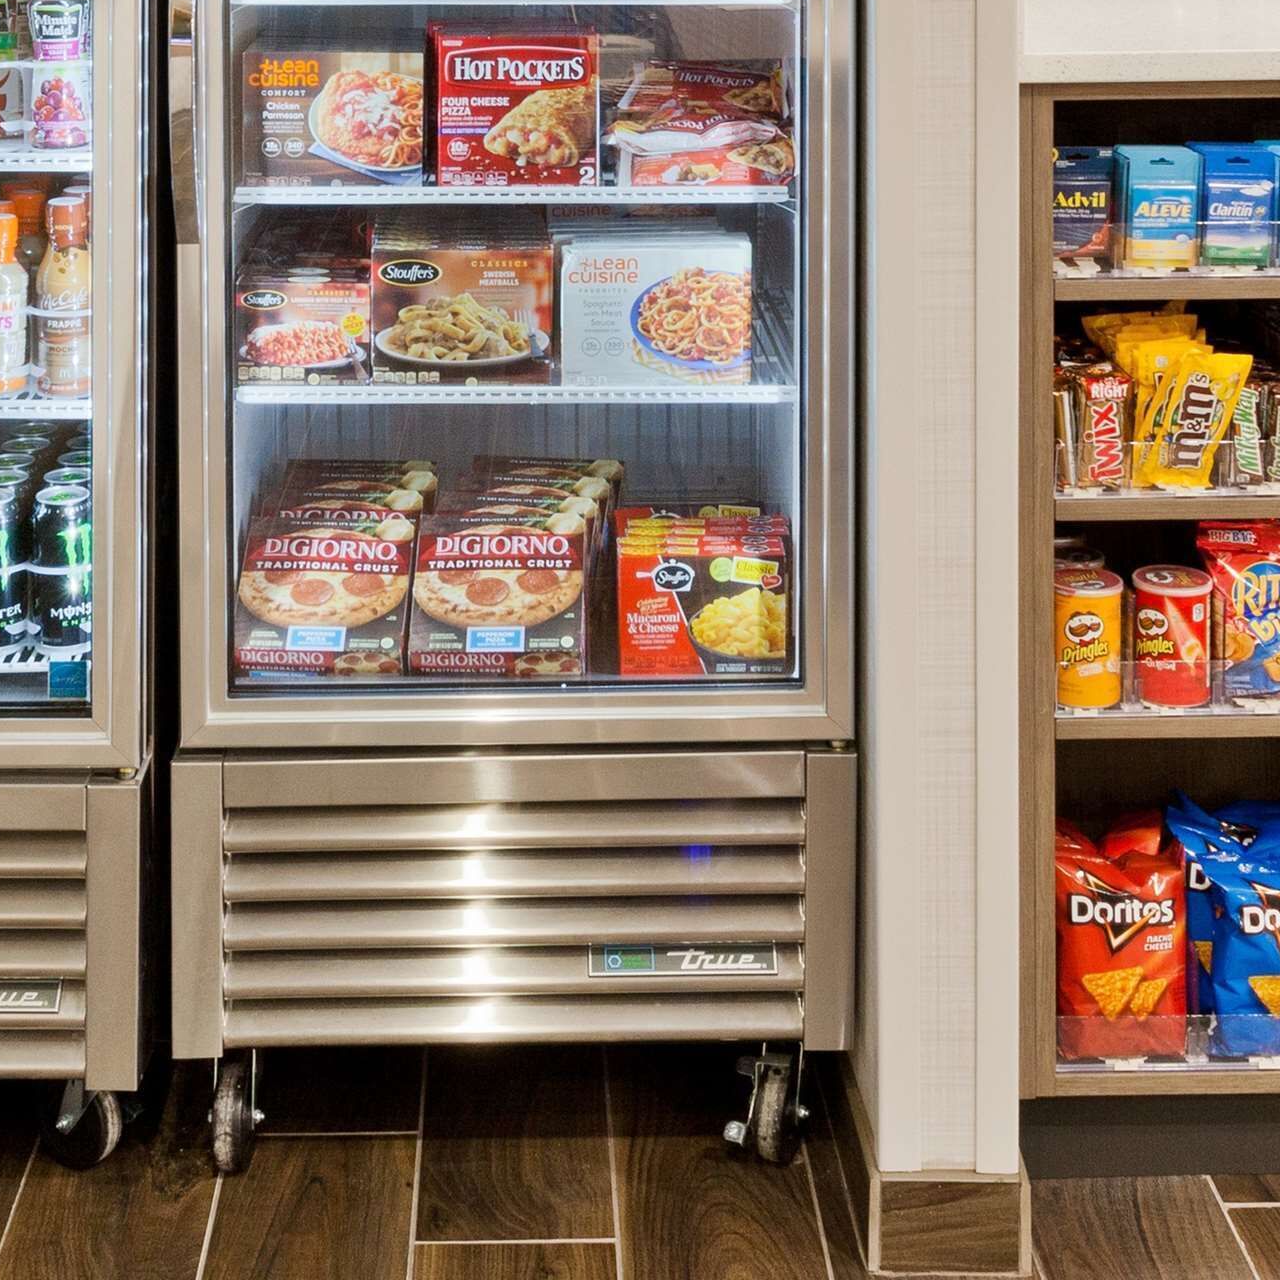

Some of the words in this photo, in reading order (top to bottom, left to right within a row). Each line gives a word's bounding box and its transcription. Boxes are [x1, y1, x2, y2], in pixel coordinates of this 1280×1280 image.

[274, 60, 319, 73] Lean
[453, 57, 495, 81] HOT
[497, 56, 585, 82] POCKETS
[266, 101, 300, 111] Chicken
[442, 97, 469, 106] FOUR
[471, 97, 510, 106] CHEESE
[262, 111, 304, 120] Parmesan
[442, 107, 471, 116] PIZZA
[579, 167, 595, 186] 2
[1053, 191, 1106, 208] Advil
[1134, 201, 1193, 218] ALEVE
[1209, 203, 1253, 217] Claritin
[471, 260, 529, 268] CLASSICS
[592, 257, 639, 270] Lean
[385, 265, 434, 281] Stouffer's
[568, 270, 639, 284] cuisine
[479, 278, 520, 286] MEATBALLS
[1091, 383, 1128, 400] RIGHT
[1083, 401, 1125, 482] TWIX
[1208, 530, 1231, 542] BIG
[263, 538, 398, 561] DIGIORNO
[435, 536, 570, 556] DIGIORNO
[256, 560, 349, 570] TRADITIONAL
[353, 563, 399, 573] CRUST
[428, 559, 522, 569] TRADITIONAL
[527, 559, 572, 569] CRUST
[626, 612, 681, 624] Macaroni
[627, 624, 638, 634] &
[639, 623, 680, 634] Cheese
[1063, 640, 1109, 663] Pringles
[1135, 636, 1175, 656] Pringles
[240, 650, 324, 665] DIGIORNO
[421, 652, 504, 666] DIGIORNO
[1070, 892, 1175, 927] Doritos
[1146, 934, 1174, 944] NACHO
[1143, 942, 1174, 952] CHEESE
[666, 948, 762, 970] true
